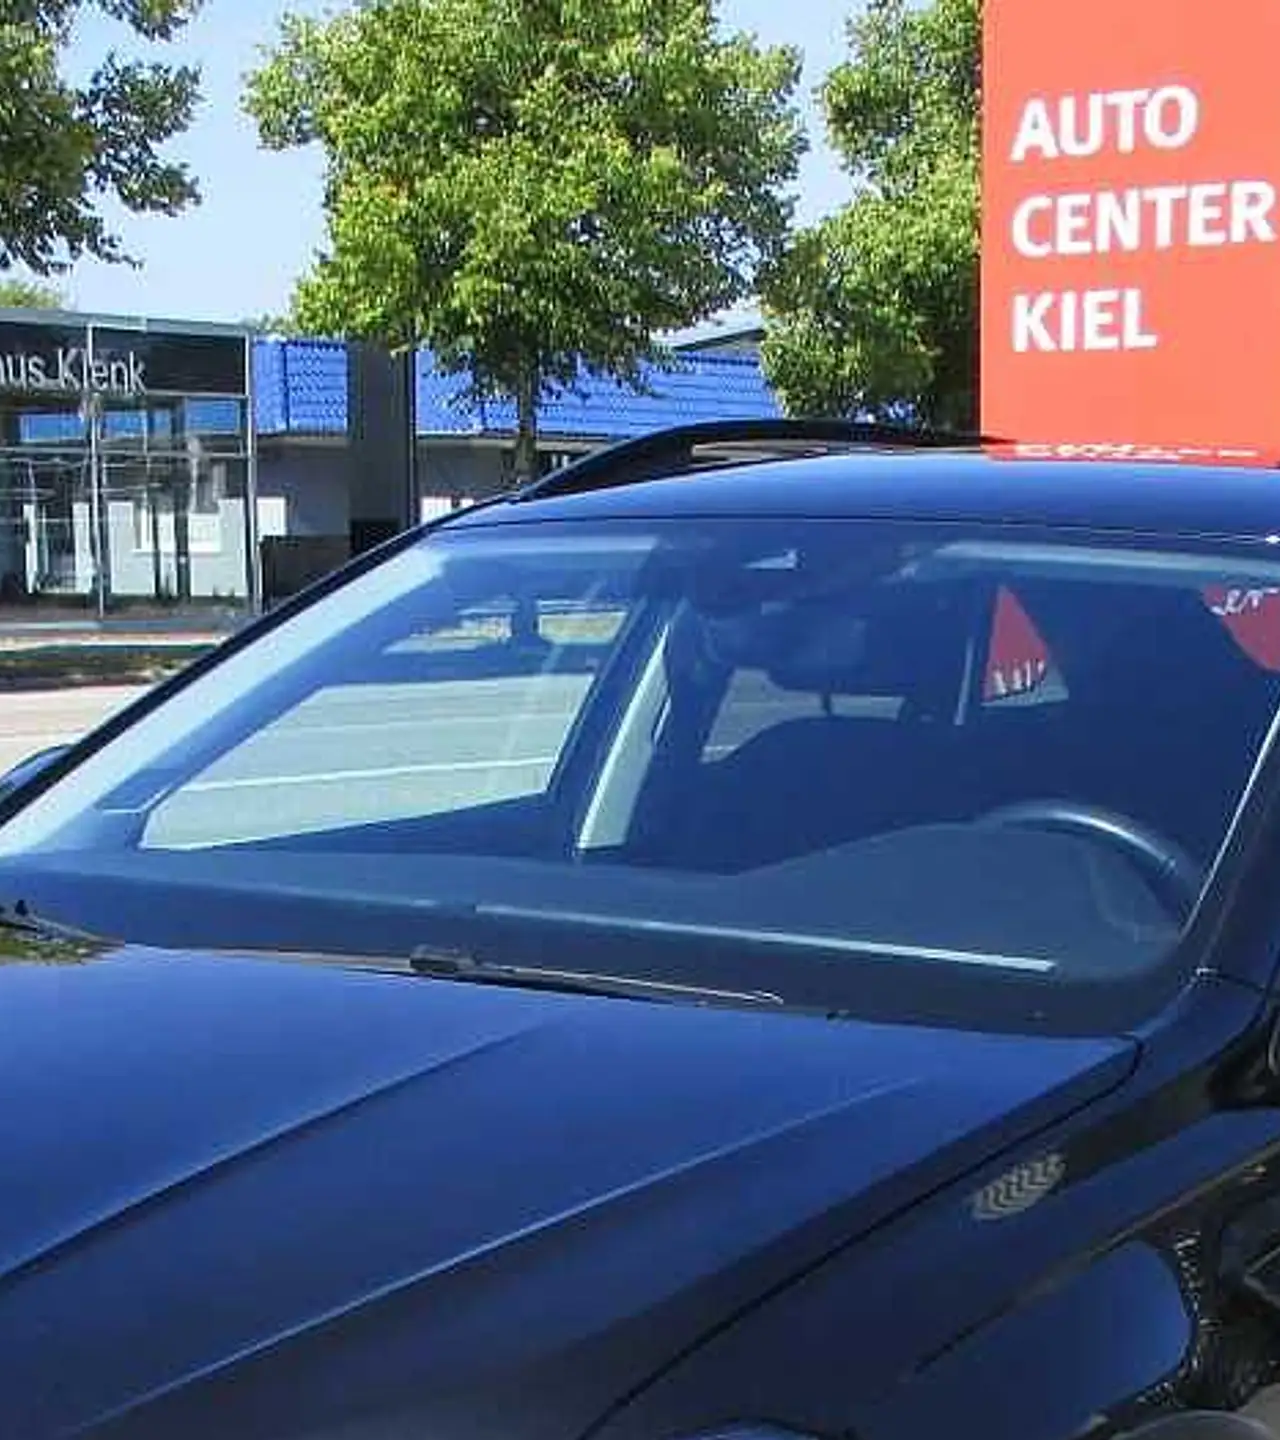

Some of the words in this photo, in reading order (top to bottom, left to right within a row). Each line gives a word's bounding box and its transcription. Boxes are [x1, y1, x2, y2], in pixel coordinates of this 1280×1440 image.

[1010, 86, 1198, 161] AUTO
[1012, 181, 1277, 258] CENTER
[1012, 287, 1157, 352] KIEL
[58, 345, 146, 394] Klenk
